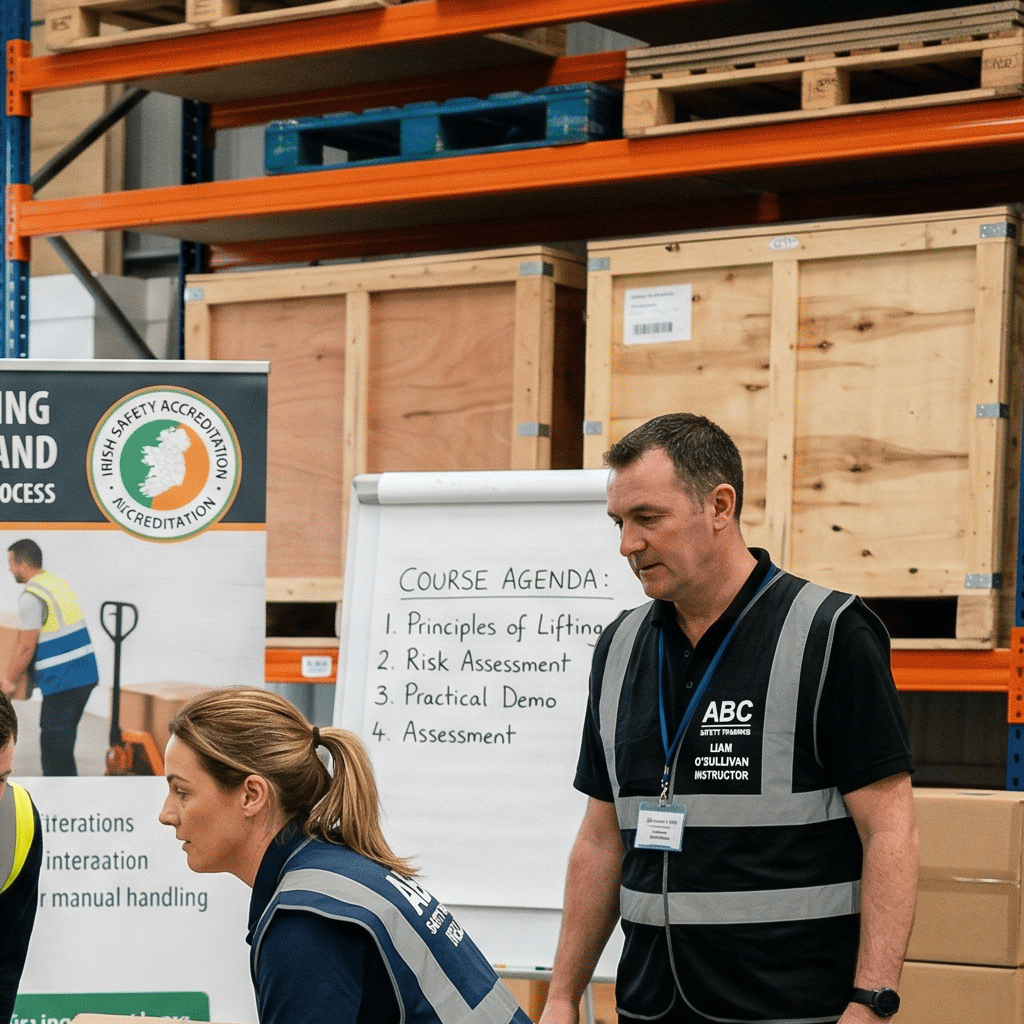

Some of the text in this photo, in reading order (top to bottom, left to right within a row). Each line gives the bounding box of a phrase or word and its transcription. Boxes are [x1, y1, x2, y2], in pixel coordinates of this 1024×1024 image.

[101, 400, 229, 480] IRISH SAFETY ACCREDITATION
[399, 567, 489, 592] COURSE
[386, 613, 397, 635] 1.
[408, 611, 497, 643] Principles
[506, 614, 527, 643] of
[377, 647, 572, 673] 2. Risk Assessment
[373, 682, 557, 709] 3. Practical Demo
[702, 699, 754, 723] ABC
[371, 720, 517, 745] 4. Assessment
[710, 743, 733, 753] LIAM
[694, 770, 749, 780] INSTRUCTOR
[46, 850, 149, 871] interaation
[52, 886, 120, 908] manual
[127, 886, 208, 913] handling
